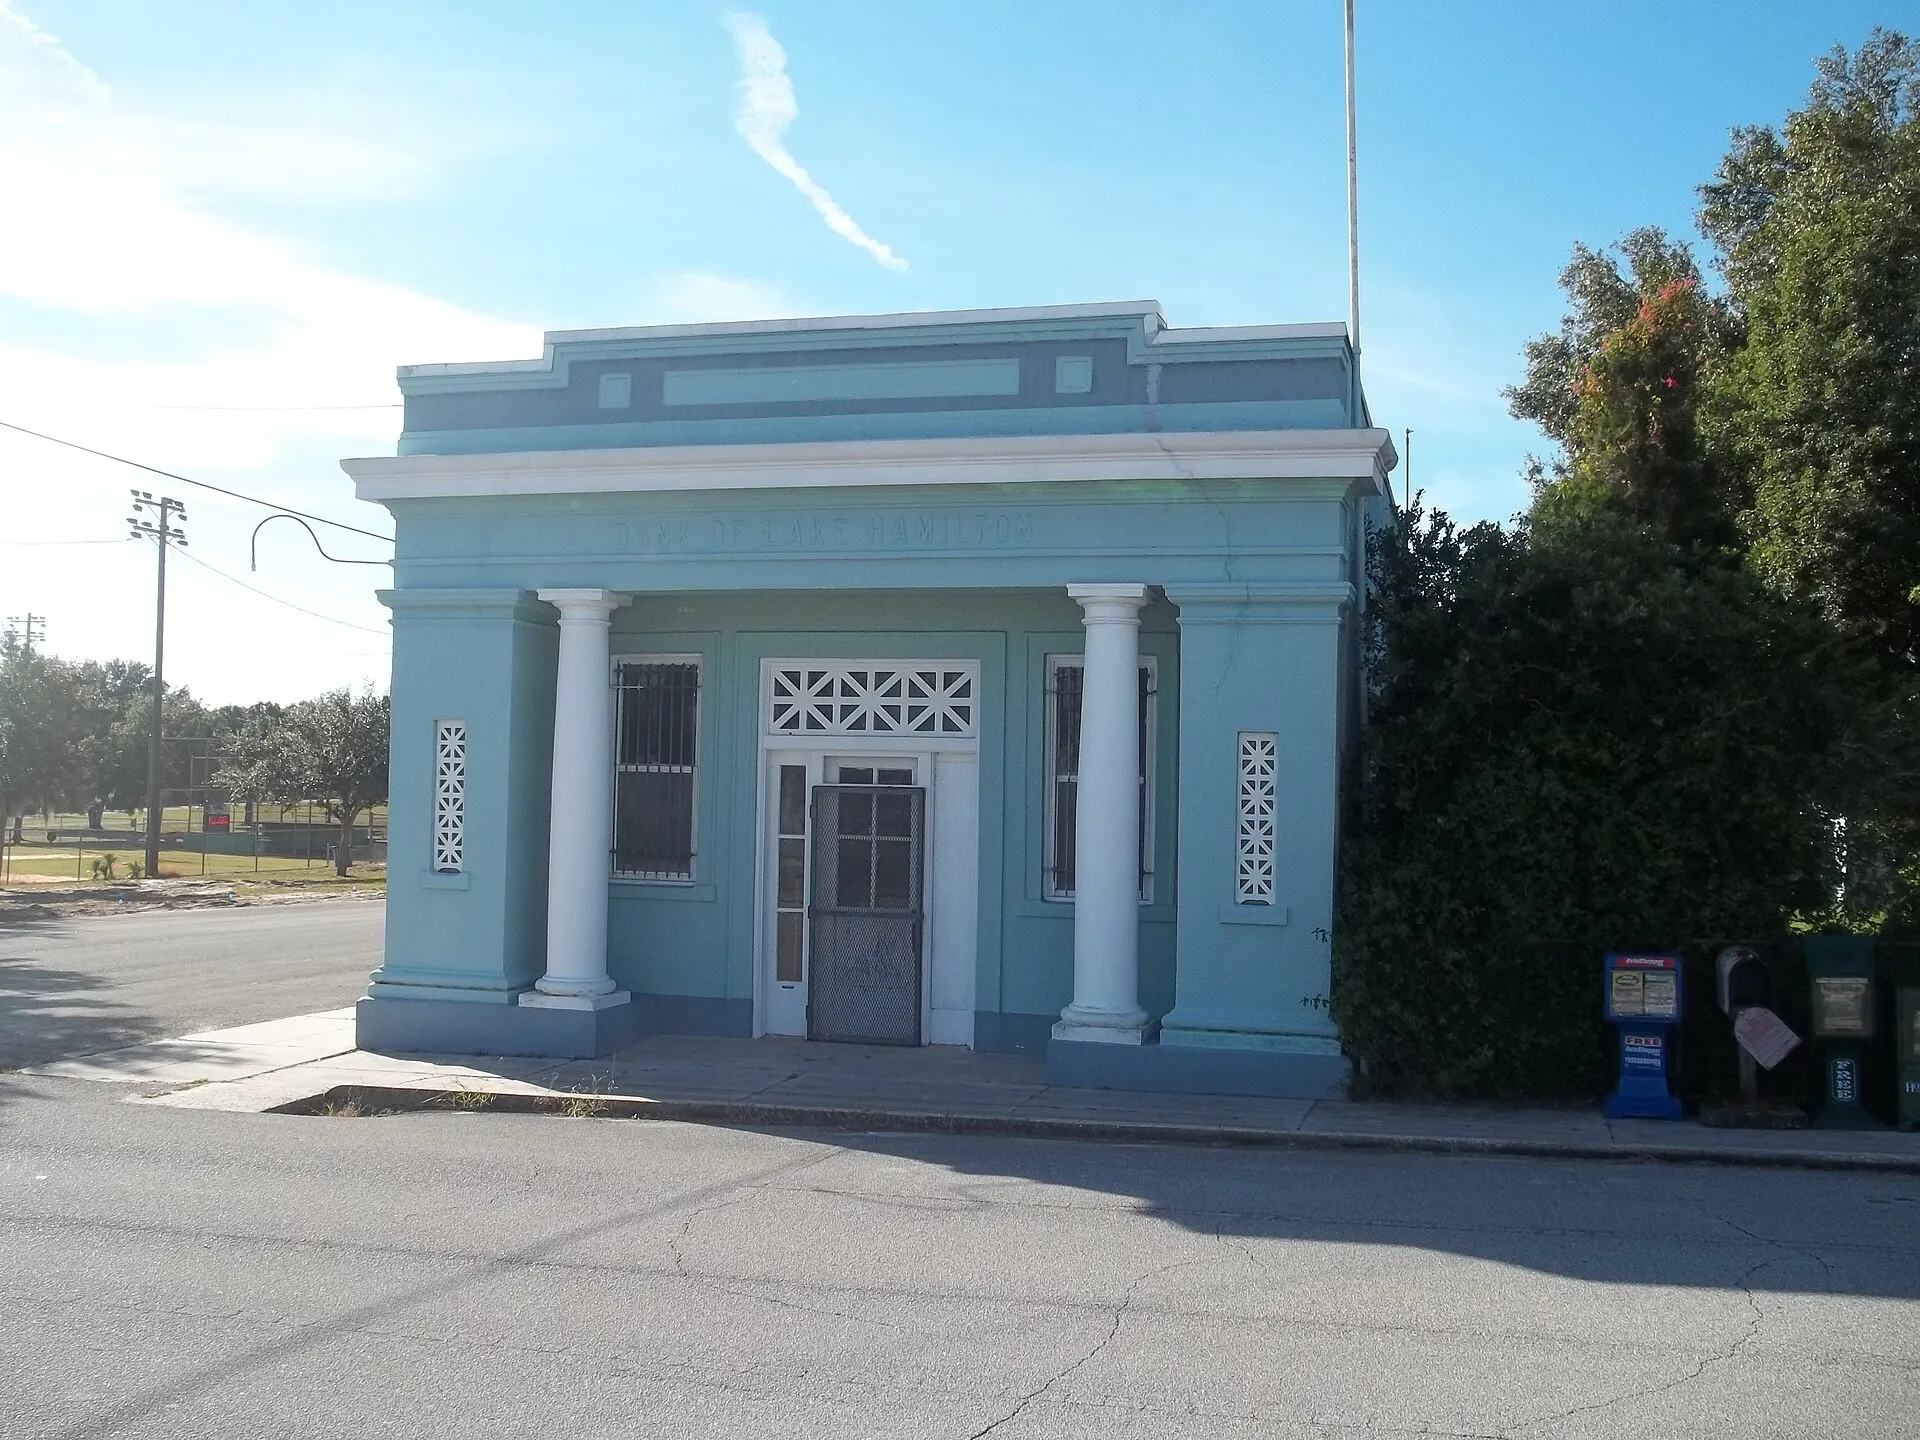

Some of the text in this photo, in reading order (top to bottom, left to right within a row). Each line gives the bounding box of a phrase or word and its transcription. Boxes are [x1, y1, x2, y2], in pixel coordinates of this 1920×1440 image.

[614, 514, 1030, 550] BANK OF LAKE HAMILTON
[1626, 1036, 1661, 1046] FREE
